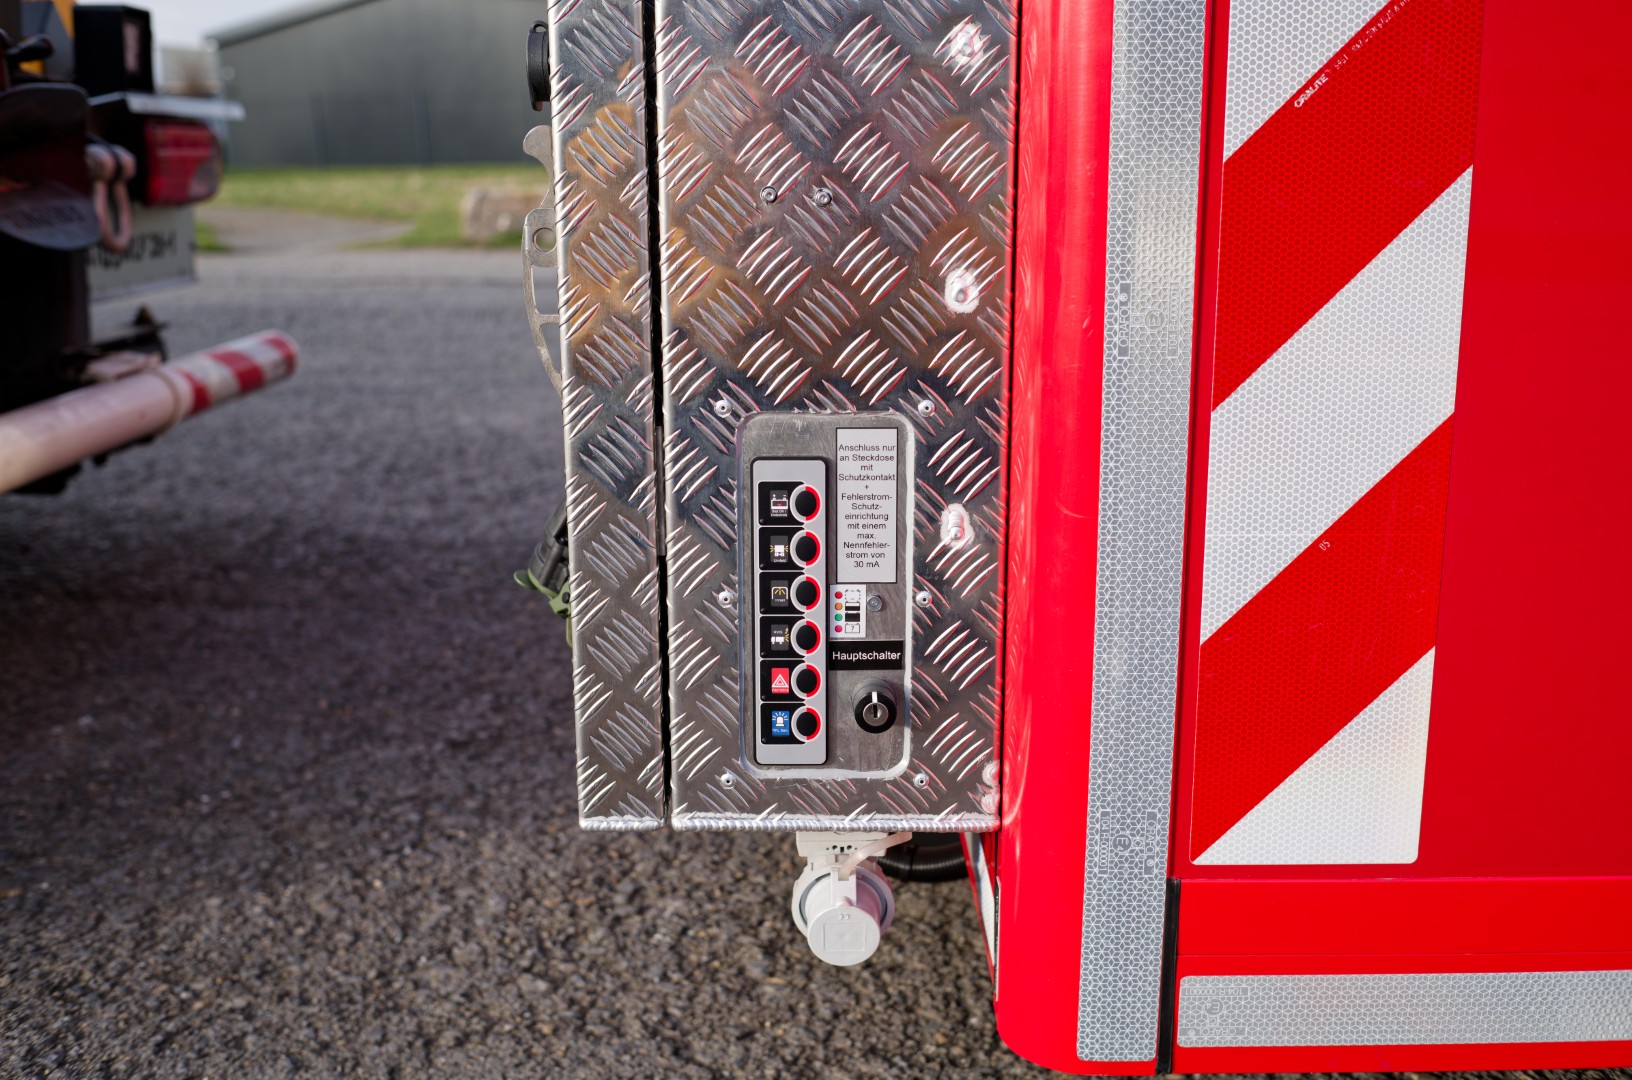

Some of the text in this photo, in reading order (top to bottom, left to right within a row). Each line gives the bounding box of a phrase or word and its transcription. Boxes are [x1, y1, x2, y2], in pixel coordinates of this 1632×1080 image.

[1294, 73, 1328, 108] ORALITE
[841, 493, 893, 501] Fehlerstrom-
[845, 513, 889, 521] einrichtung
[843, 541, 891, 549] Nennfehler-
[832, 651, 901, 662] Hauptschalter
[1145, 820, 1156, 856] ORAFOL
